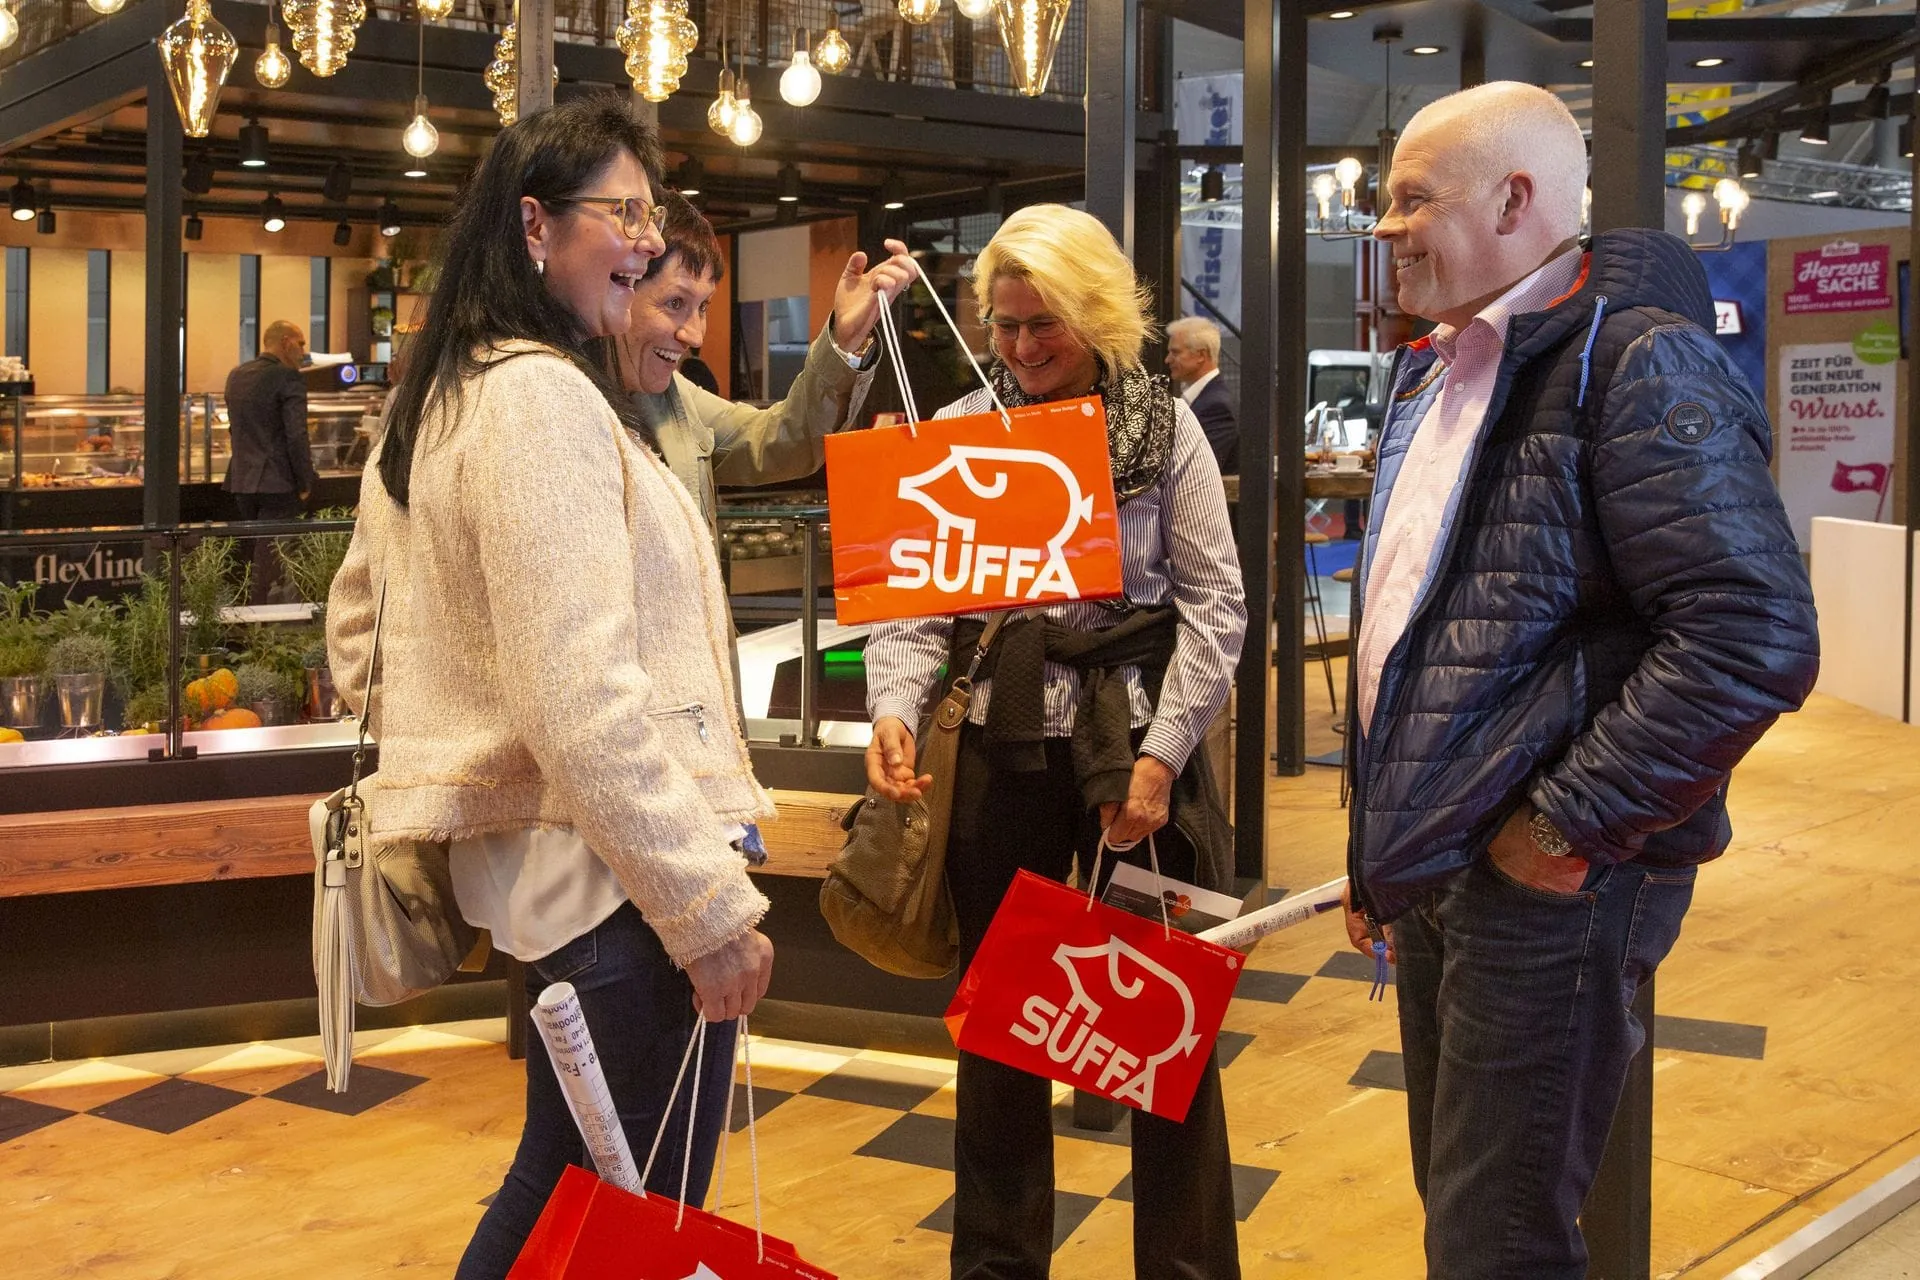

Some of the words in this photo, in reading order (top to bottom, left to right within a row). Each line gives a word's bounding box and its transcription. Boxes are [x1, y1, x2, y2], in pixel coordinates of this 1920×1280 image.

[1798, 261, 1880, 282] Herzens
[1817, 275, 1879, 294] SACHE
[1791, 358, 1820, 370] ZEIT
[1824, 355, 1853, 367] FÜR
[1791, 371, 1822, 382] EINE
[1826, 369, 1864, 380] NEUE
[1790, 382, 1881, 395] GENERATION
[1789, 397, 1884, 419] Wurst.
